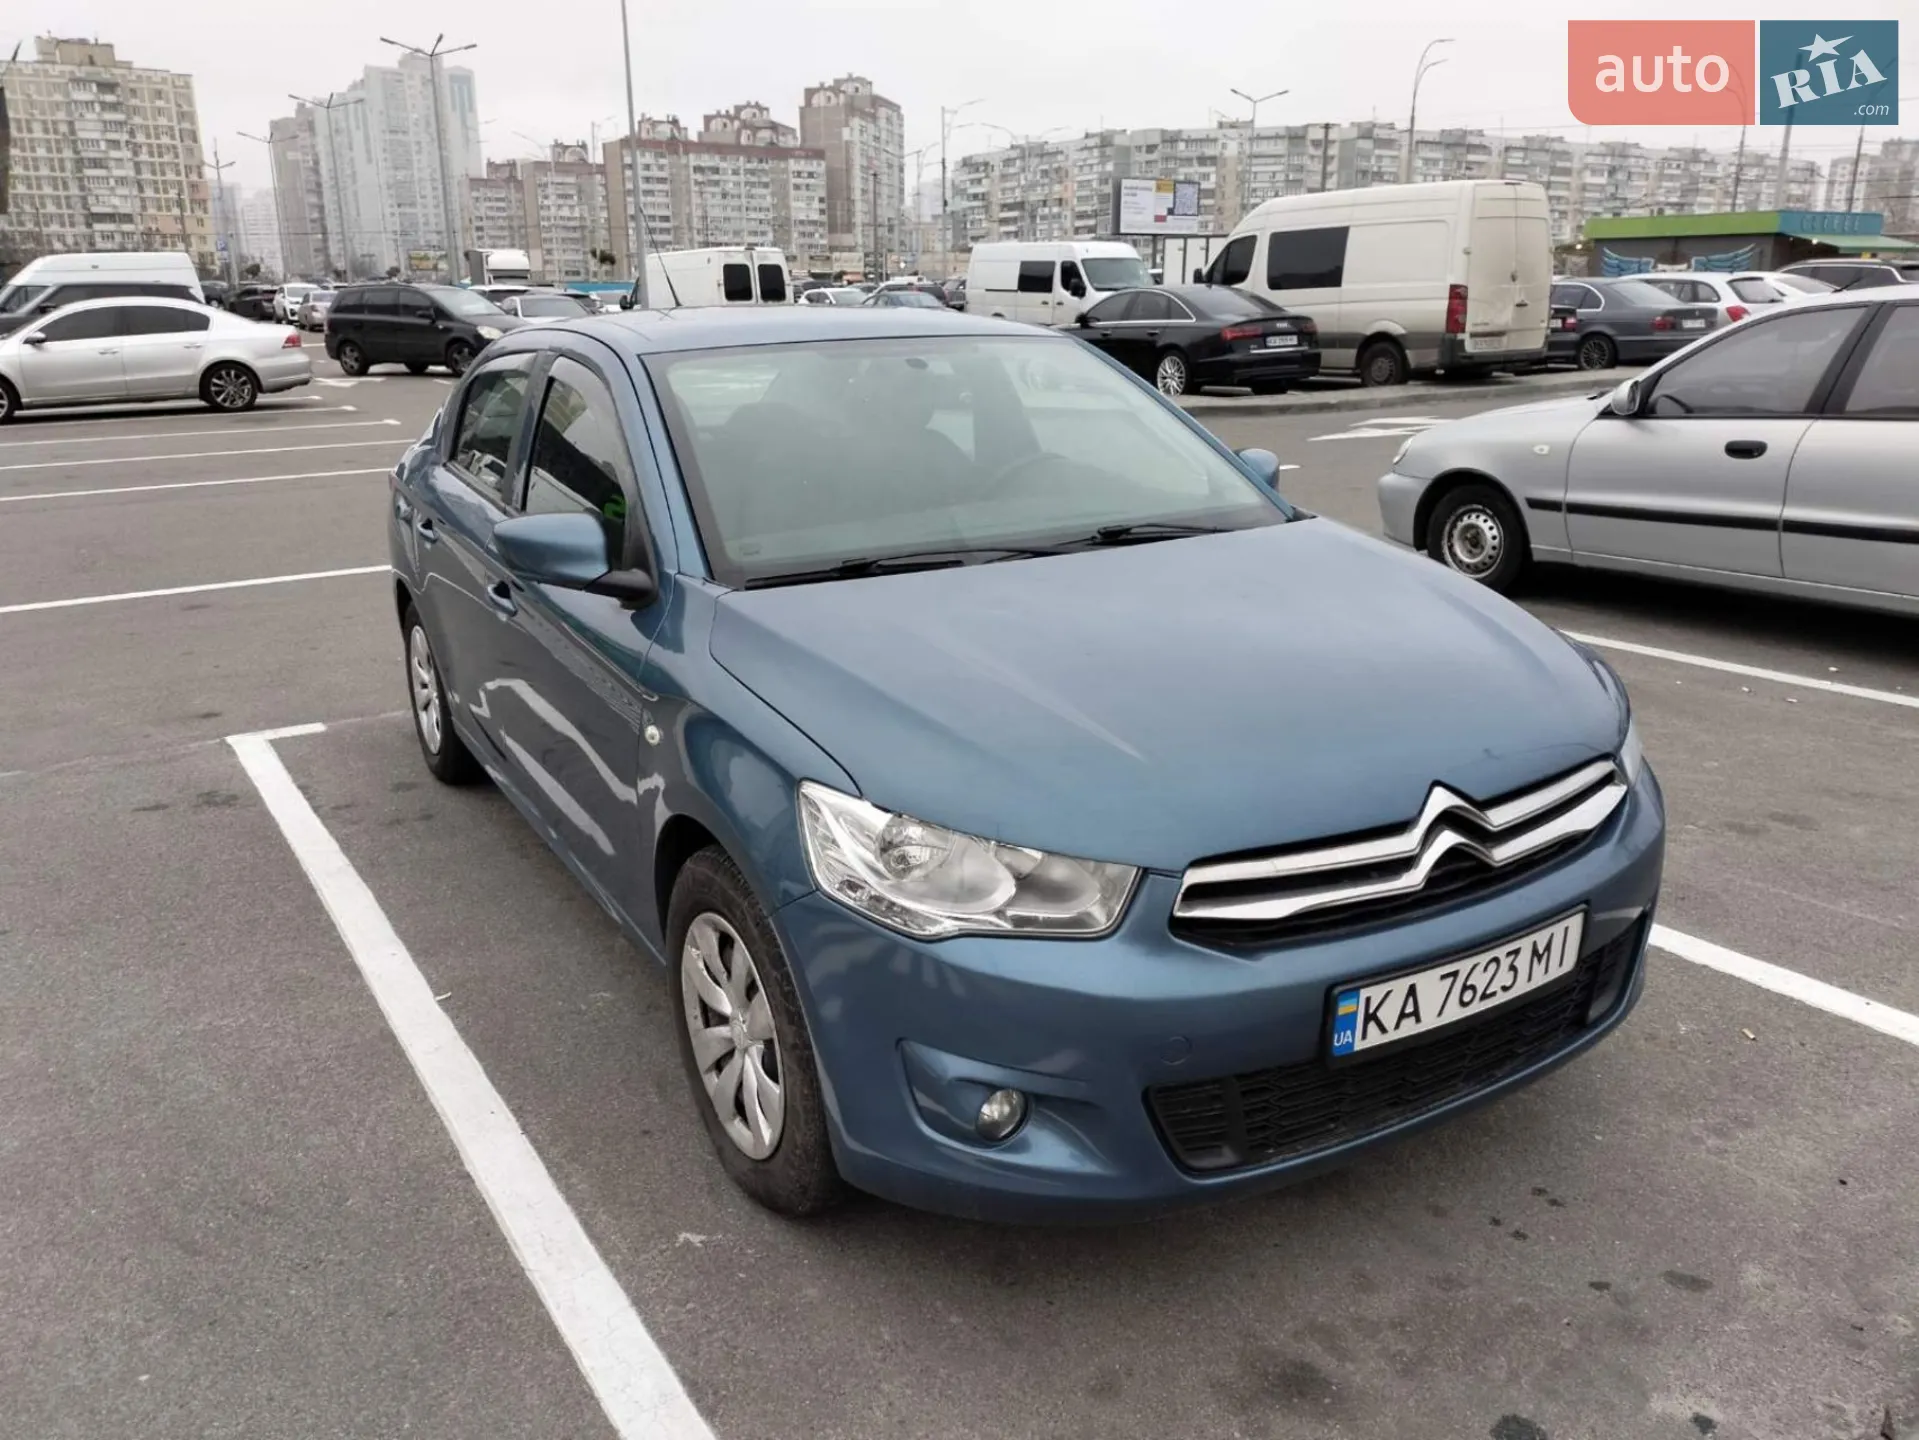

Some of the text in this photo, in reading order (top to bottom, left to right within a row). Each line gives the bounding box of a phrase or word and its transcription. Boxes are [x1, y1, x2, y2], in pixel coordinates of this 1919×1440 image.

[1360, 926, 1569, 1040] KA 7623 MI
[1334, 1030, 1353, 1047] UA
